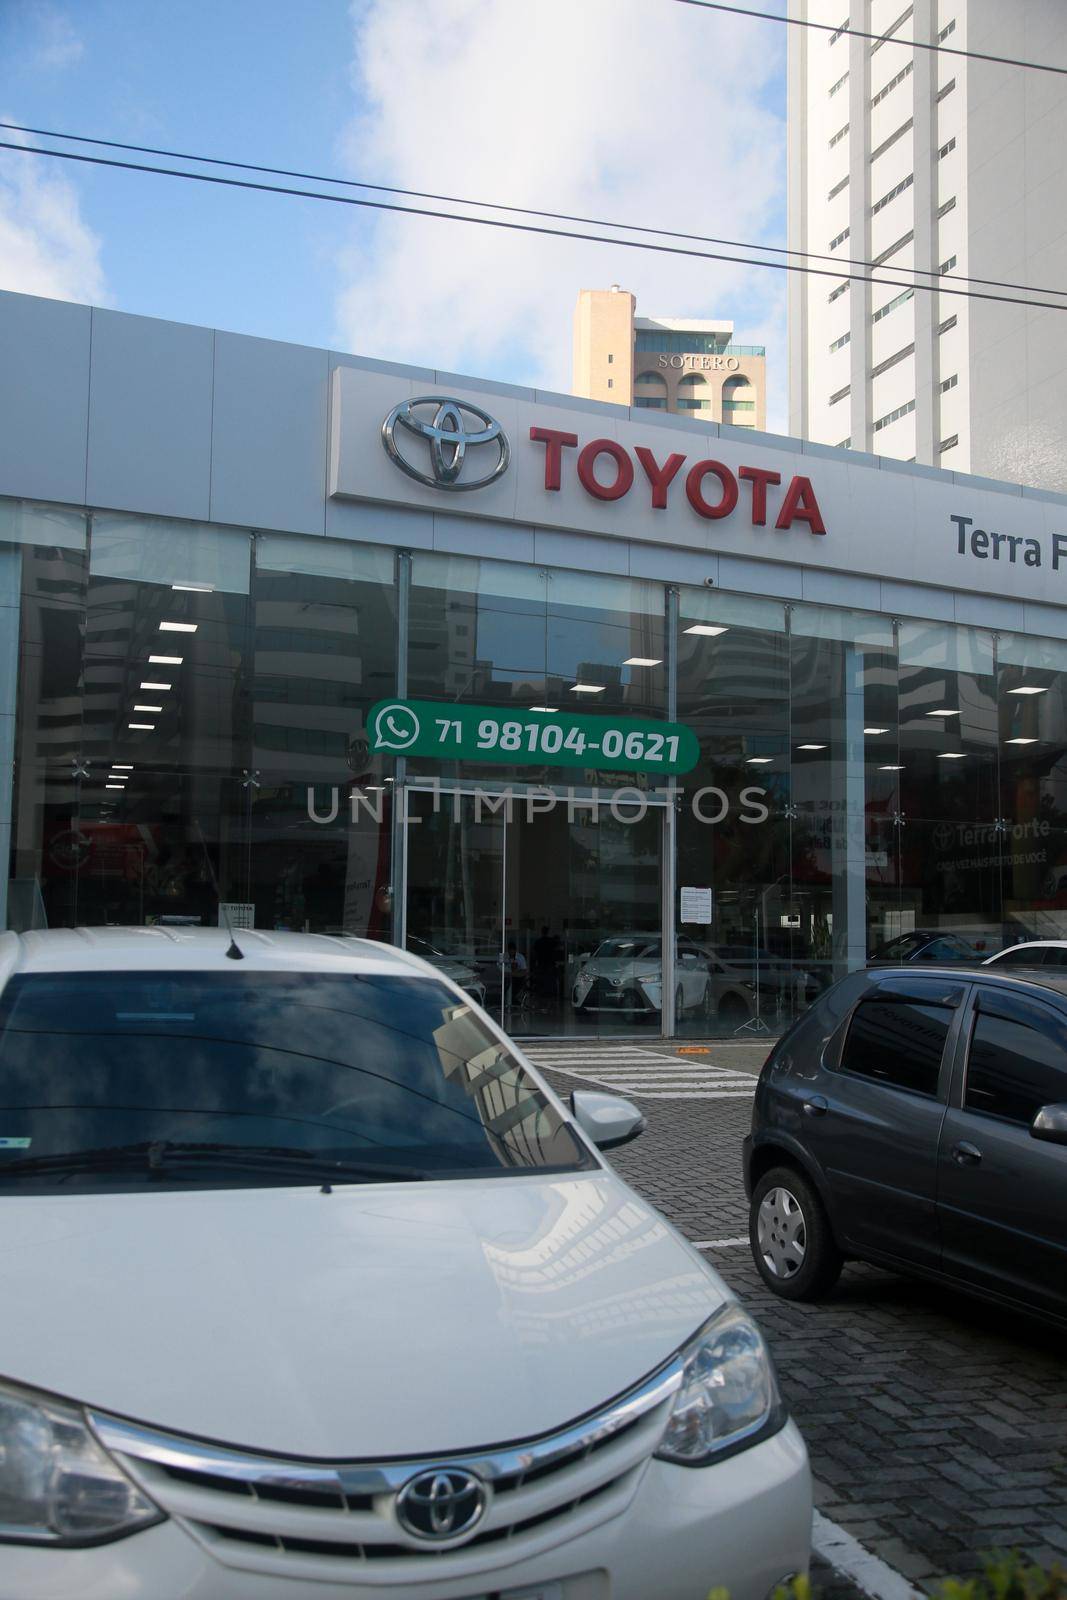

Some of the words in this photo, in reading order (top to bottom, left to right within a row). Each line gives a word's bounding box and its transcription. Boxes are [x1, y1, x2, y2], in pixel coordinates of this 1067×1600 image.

[658, 354, 740, 372] SOTERO
[529, 426, 827, 536] TOYOTA
[950, 514, 1042, 567] Terra
[435, 719, 462, 744] 71
[476, 719, 680, 762] 98104-0621
